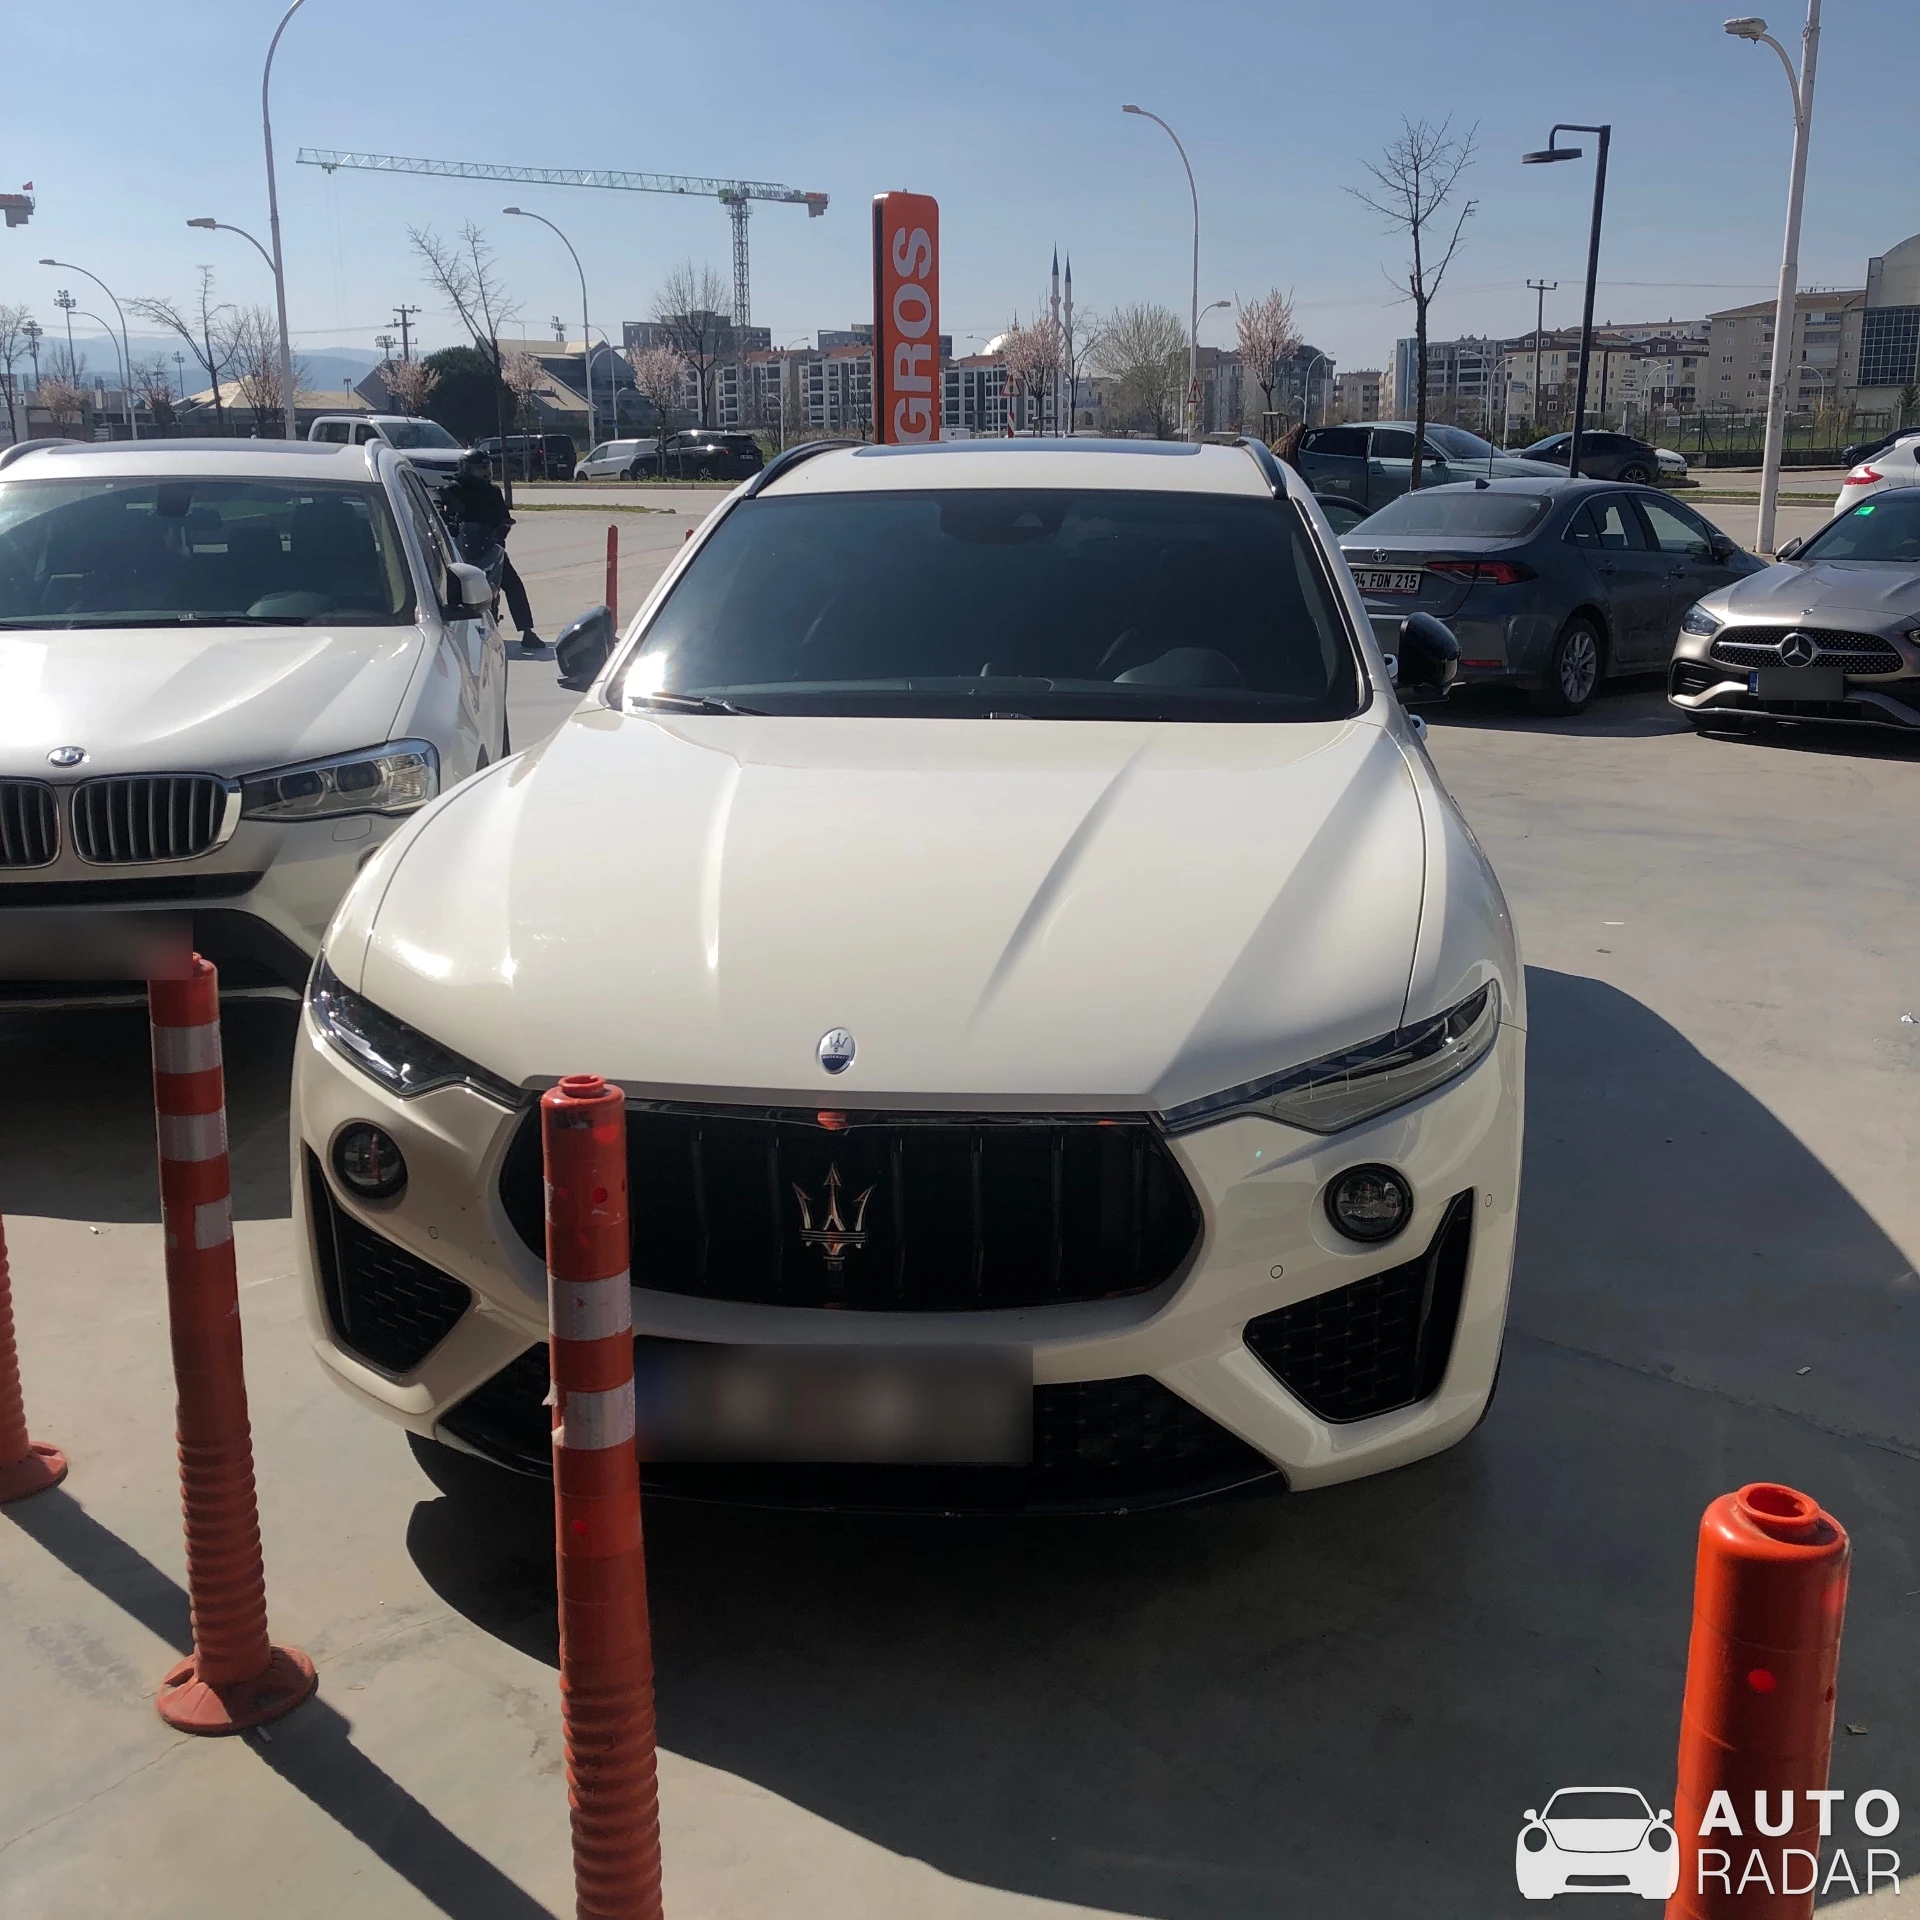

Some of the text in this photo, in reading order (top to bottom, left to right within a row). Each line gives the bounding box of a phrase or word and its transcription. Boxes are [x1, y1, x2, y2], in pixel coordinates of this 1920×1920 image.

[892, 227, 932, 442] GROS
[1369, 573, 1392, 588] FDN
[1394, 574, 1417, 589] 215
